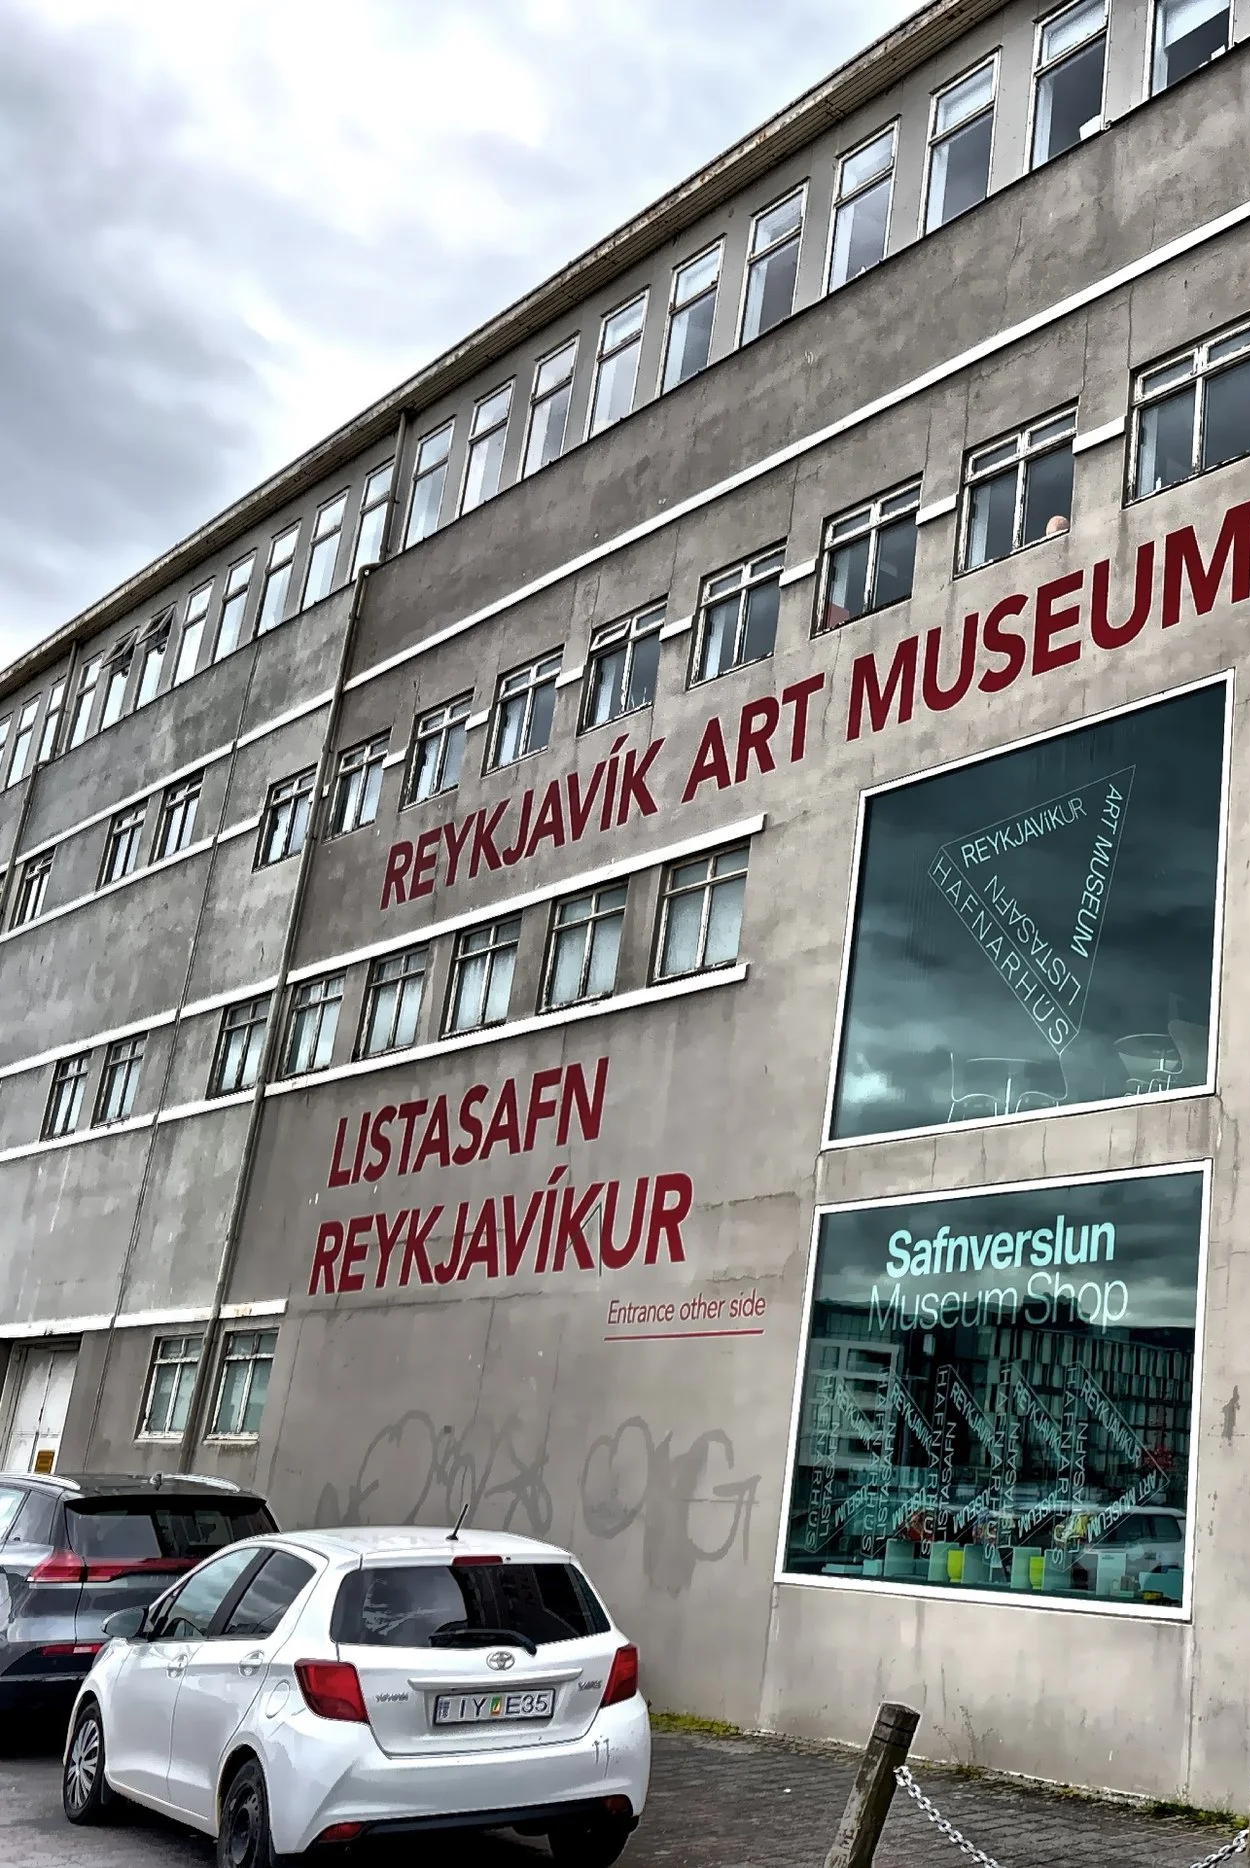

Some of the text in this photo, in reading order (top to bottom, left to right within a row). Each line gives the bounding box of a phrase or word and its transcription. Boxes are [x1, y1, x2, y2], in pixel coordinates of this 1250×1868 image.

[380, 734, 666, 911] REYKJAVÍK
[683, 675, 827, 802] ART
[1070, 783, 1123, 959] ART MUSEUM
[932, 856, 1069, 1045] HAFNARHÚS
[984, 874, 1081, 1006] LISTASAFN
[327, 1056, 610, 1189] LISTASAFN
[308, 1164, 694, 1297] REYKJAVÍKUR
[886, 1214, 1116, 1278] Safnverslun
[607, 1288, 766, 1325] Entrance other side
[867, 1271, 1129, 1335] Museum Shop
[505, 1693, 549, 1715] E35
